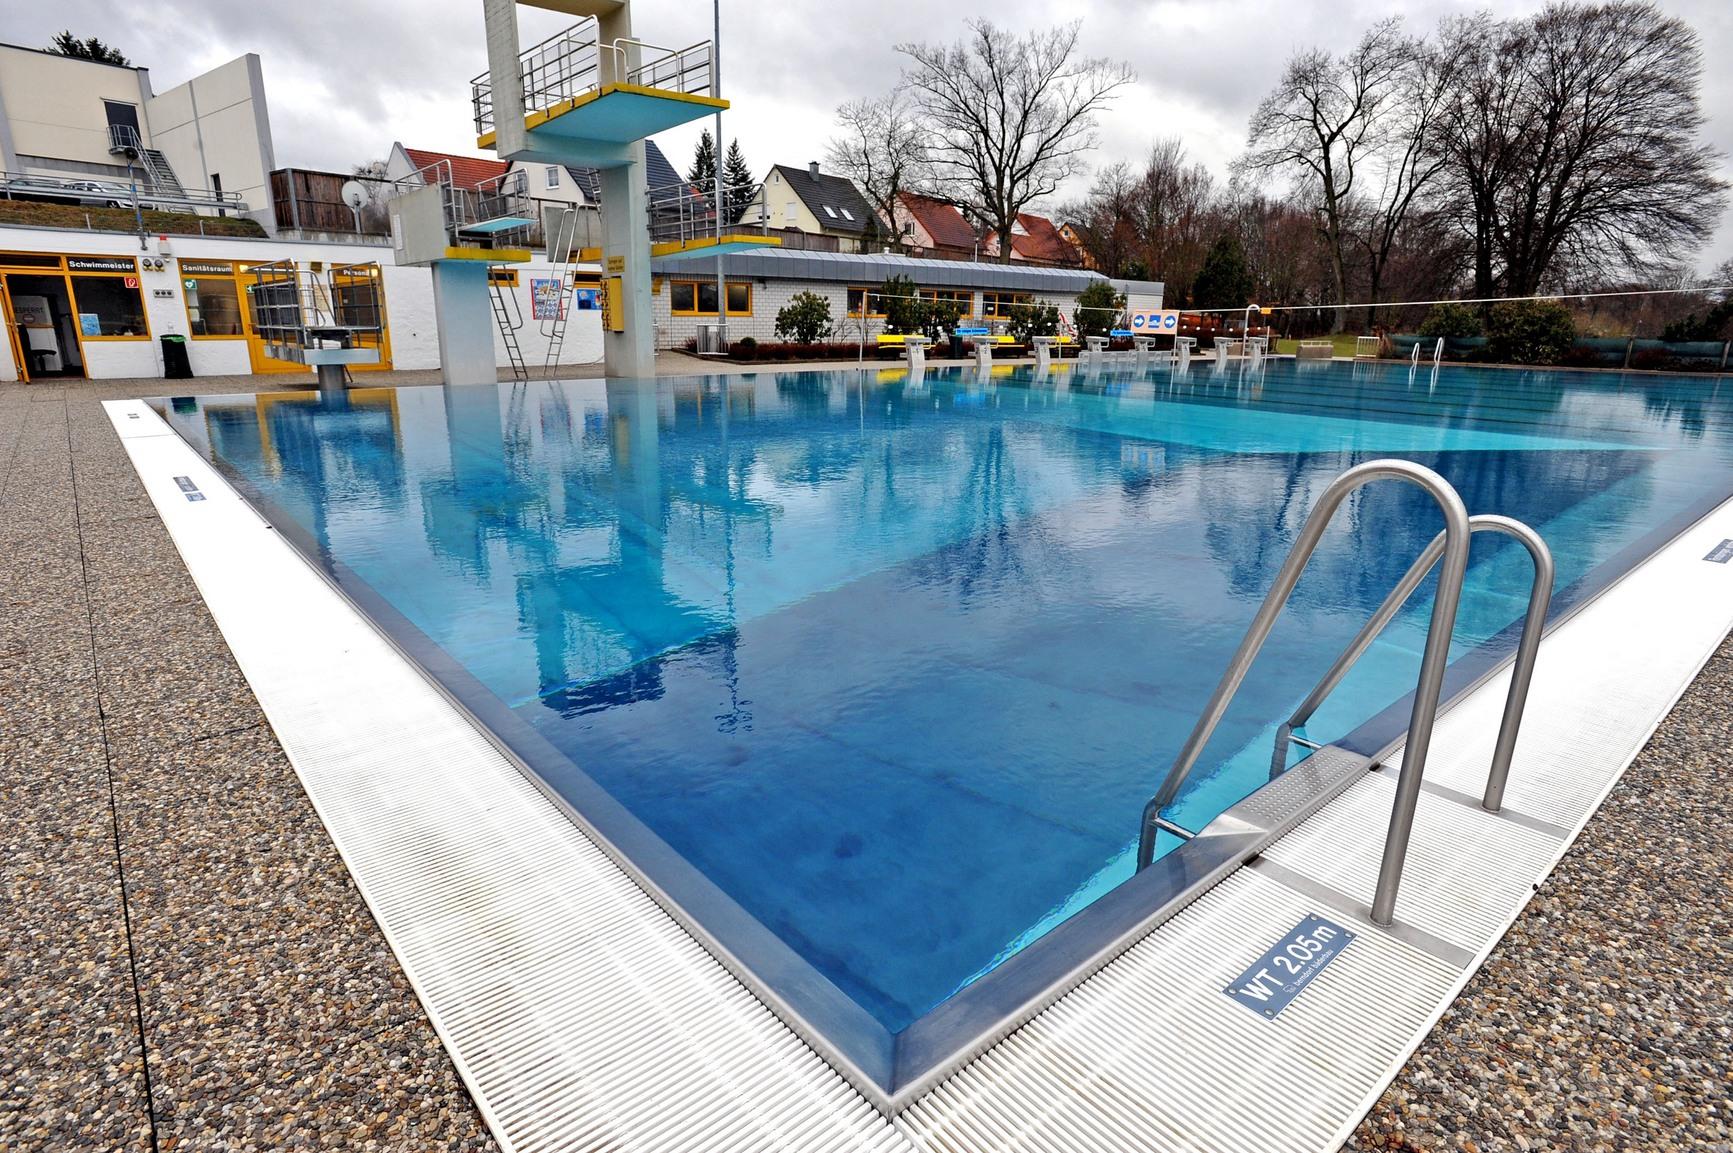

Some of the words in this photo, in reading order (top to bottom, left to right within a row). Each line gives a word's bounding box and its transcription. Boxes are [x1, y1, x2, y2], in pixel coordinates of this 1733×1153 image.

[69, 260, 134, 269] Schwimmeister
[182, 264, 233, 272] Sanitätsraum
[1239, 968, 1284, 1001] WT
[1272, 925, 1338, 975] 2.05m
